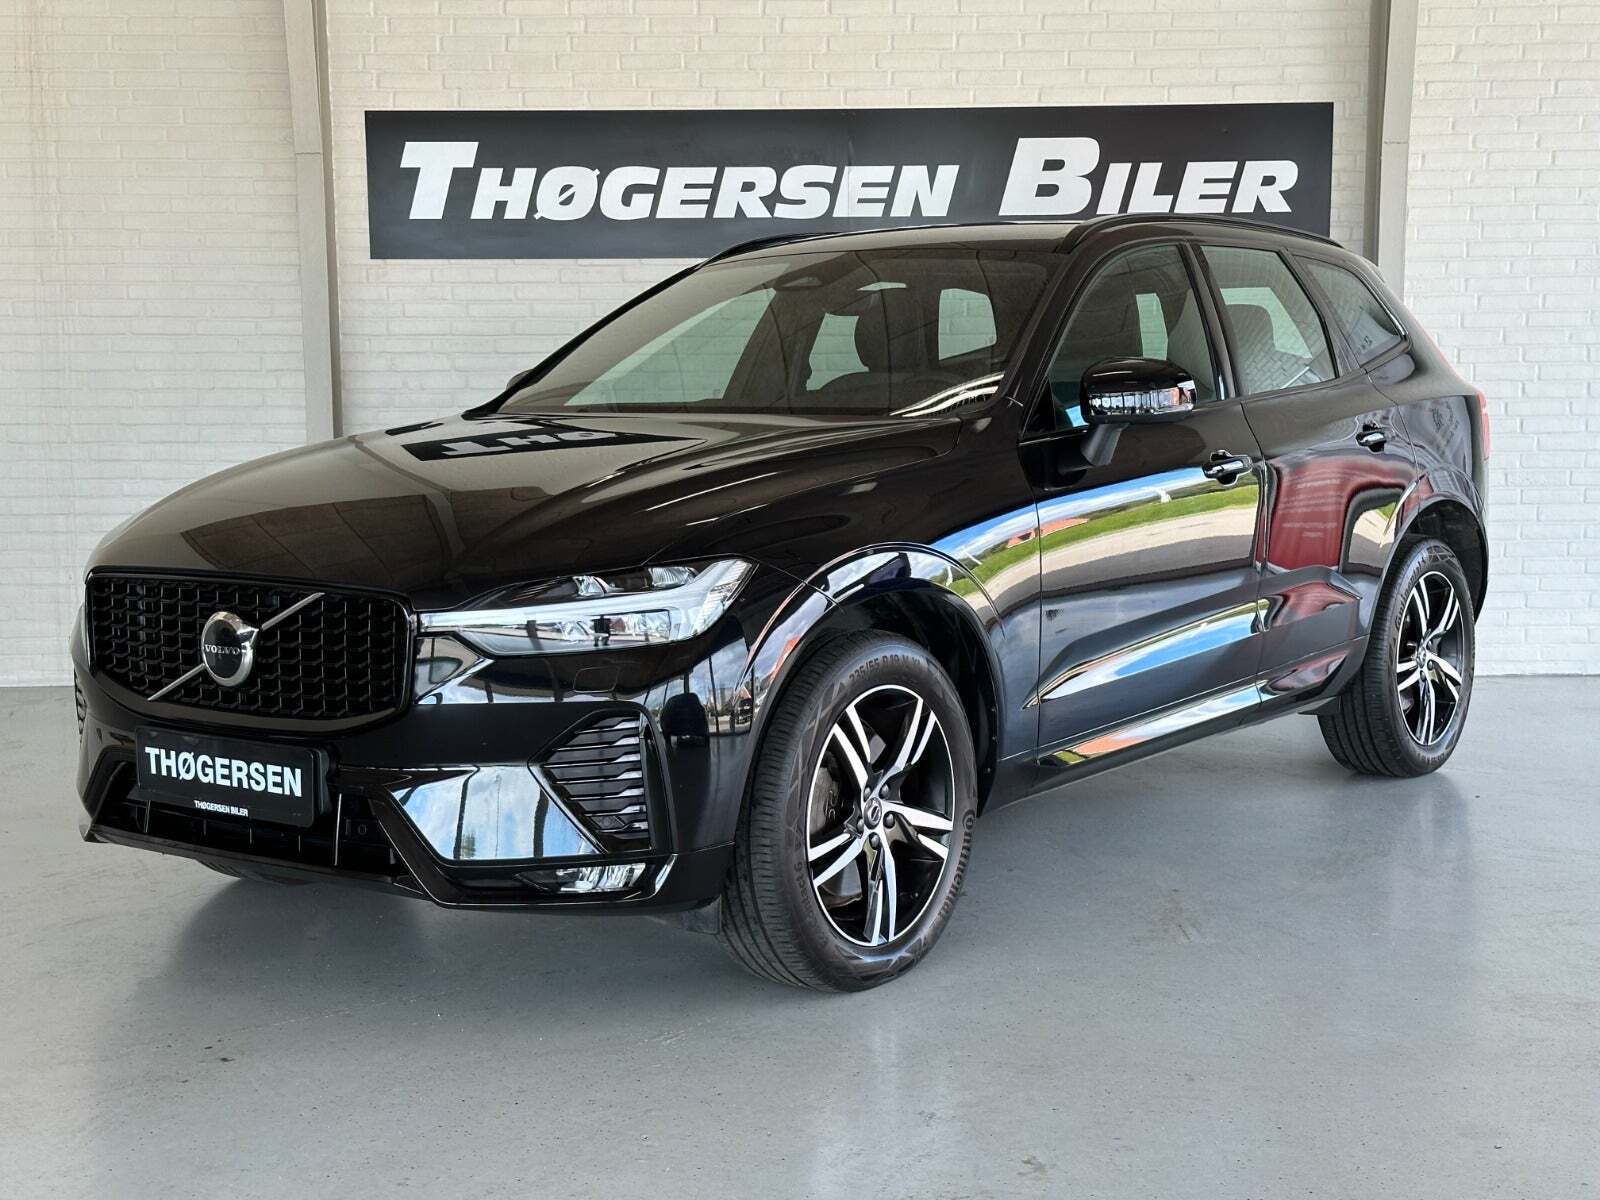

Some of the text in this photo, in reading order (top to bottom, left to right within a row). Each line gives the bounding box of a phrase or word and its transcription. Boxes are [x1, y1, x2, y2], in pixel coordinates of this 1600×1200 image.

[400, 137, 1299, 221] THØGERSEN BILER
[204, 644, 241, 656] VOLVO
[145, 746, 302, 798] THØGERSEN
[194, 800, 249, 817] THØGERSEN BILER
